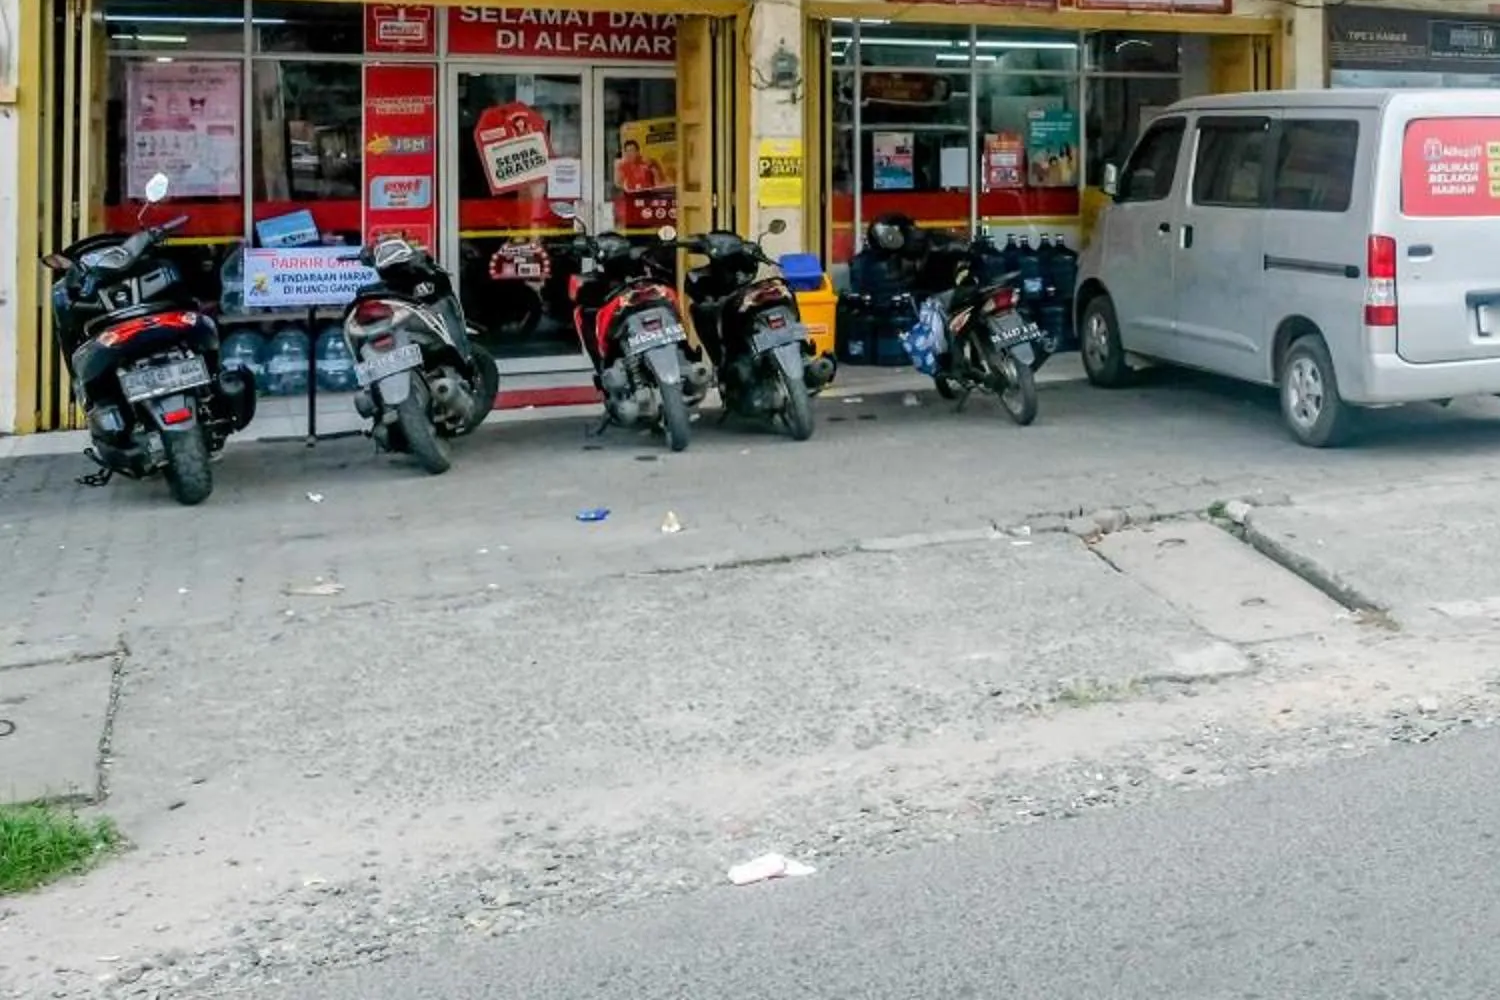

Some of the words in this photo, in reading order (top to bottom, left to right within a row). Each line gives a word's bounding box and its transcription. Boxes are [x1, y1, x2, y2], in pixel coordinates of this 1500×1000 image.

[608, 11, 678, 30] DATA
[496, 29, 524, 50] DI
[495, 147, 538, 166] SERBA
[1427, 162, 1479, 173] APLIKASI
[271, 257, 324, 269] PARKIR
[273, 272, 338, 283] KENDARAAN
[283, 285, 295, 295] DI
